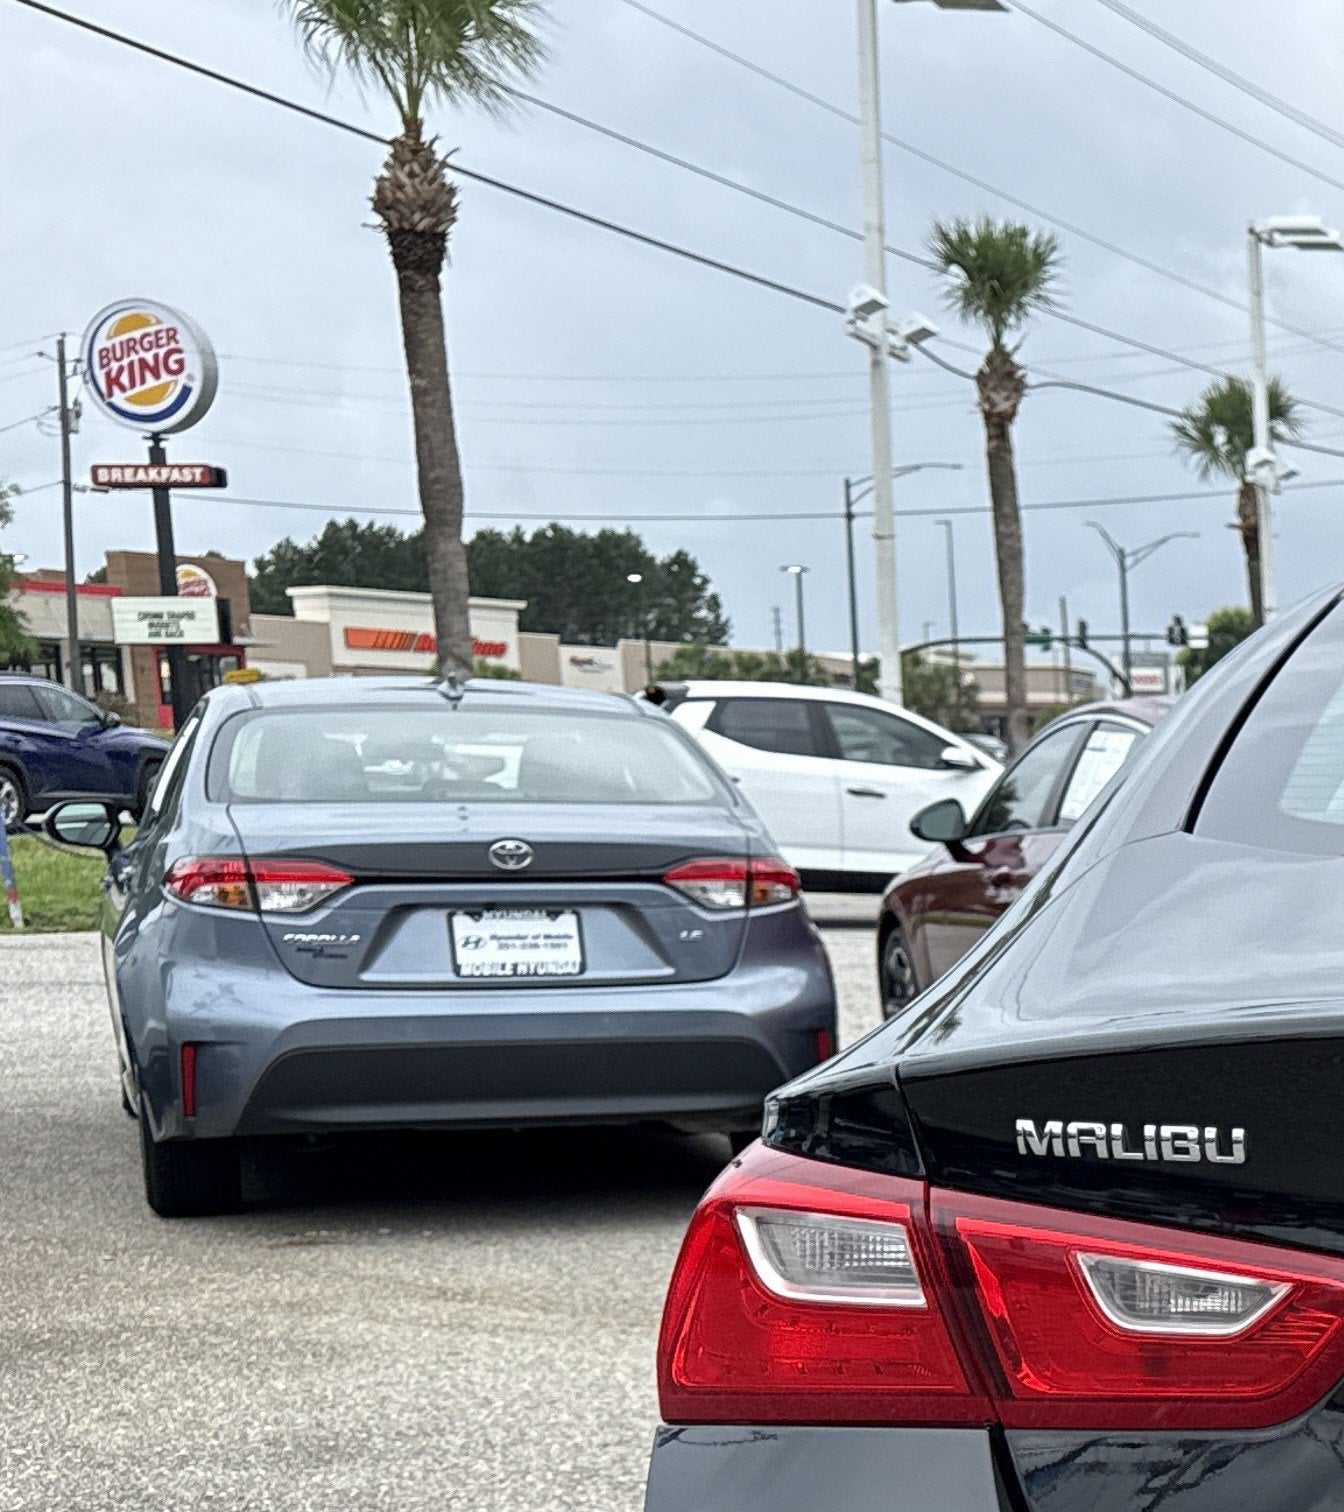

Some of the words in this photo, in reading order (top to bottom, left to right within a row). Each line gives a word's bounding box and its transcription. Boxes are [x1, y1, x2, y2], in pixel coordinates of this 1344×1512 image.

[98, 327, 180, 370] BURGER
[104, 347, 185, 400] KING
[96, 467, 204, 484] BREAKFAST
[1015, 1119, 1246, 1164] MALIBU
